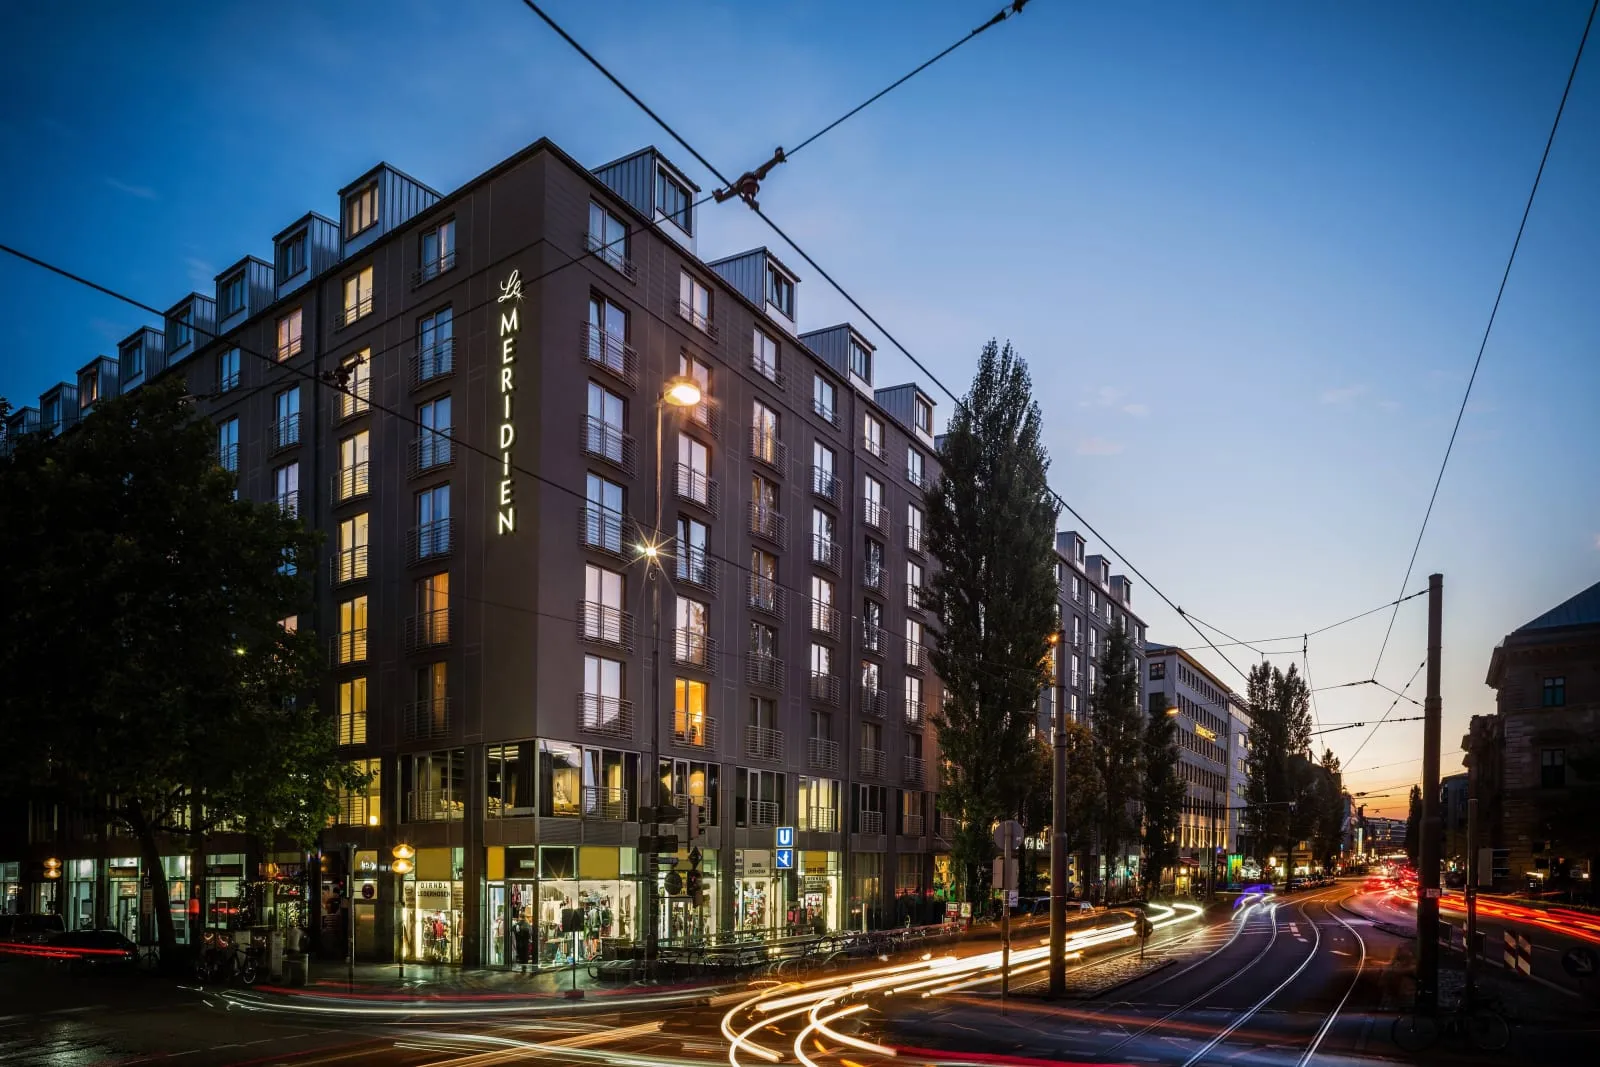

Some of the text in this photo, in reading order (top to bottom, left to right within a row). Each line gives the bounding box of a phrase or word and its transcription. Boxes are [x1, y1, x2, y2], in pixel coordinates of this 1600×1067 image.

[497, 269, 523, 303] Le
[498, 307, 519, 535] MERIDIEN
[780, 830, 790, 844] U
